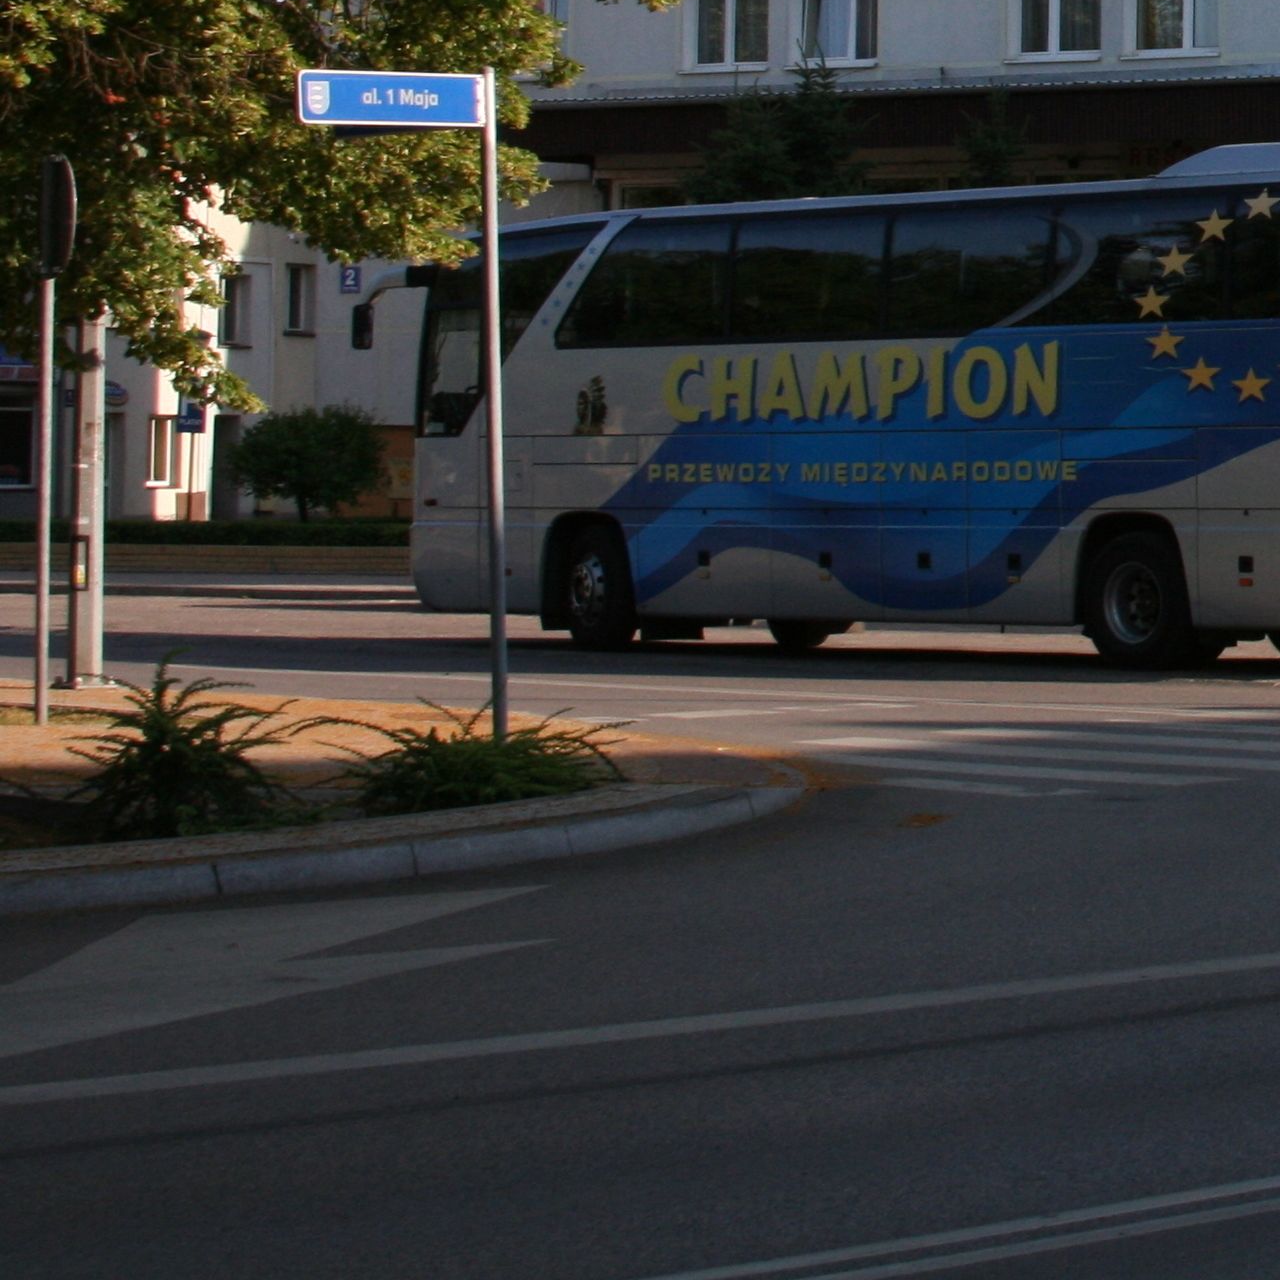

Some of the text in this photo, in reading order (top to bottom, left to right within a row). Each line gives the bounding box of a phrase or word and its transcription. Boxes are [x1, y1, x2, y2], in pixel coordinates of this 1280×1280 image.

[363, 87, 438, 109] al. 1 Maja
[345, 269, 356, 285] 2
[662, 340, 1061, 423] CHAMPION
[647, 459, 1079, 487] PRZEWOZY MIĘDZYNARODOWE
